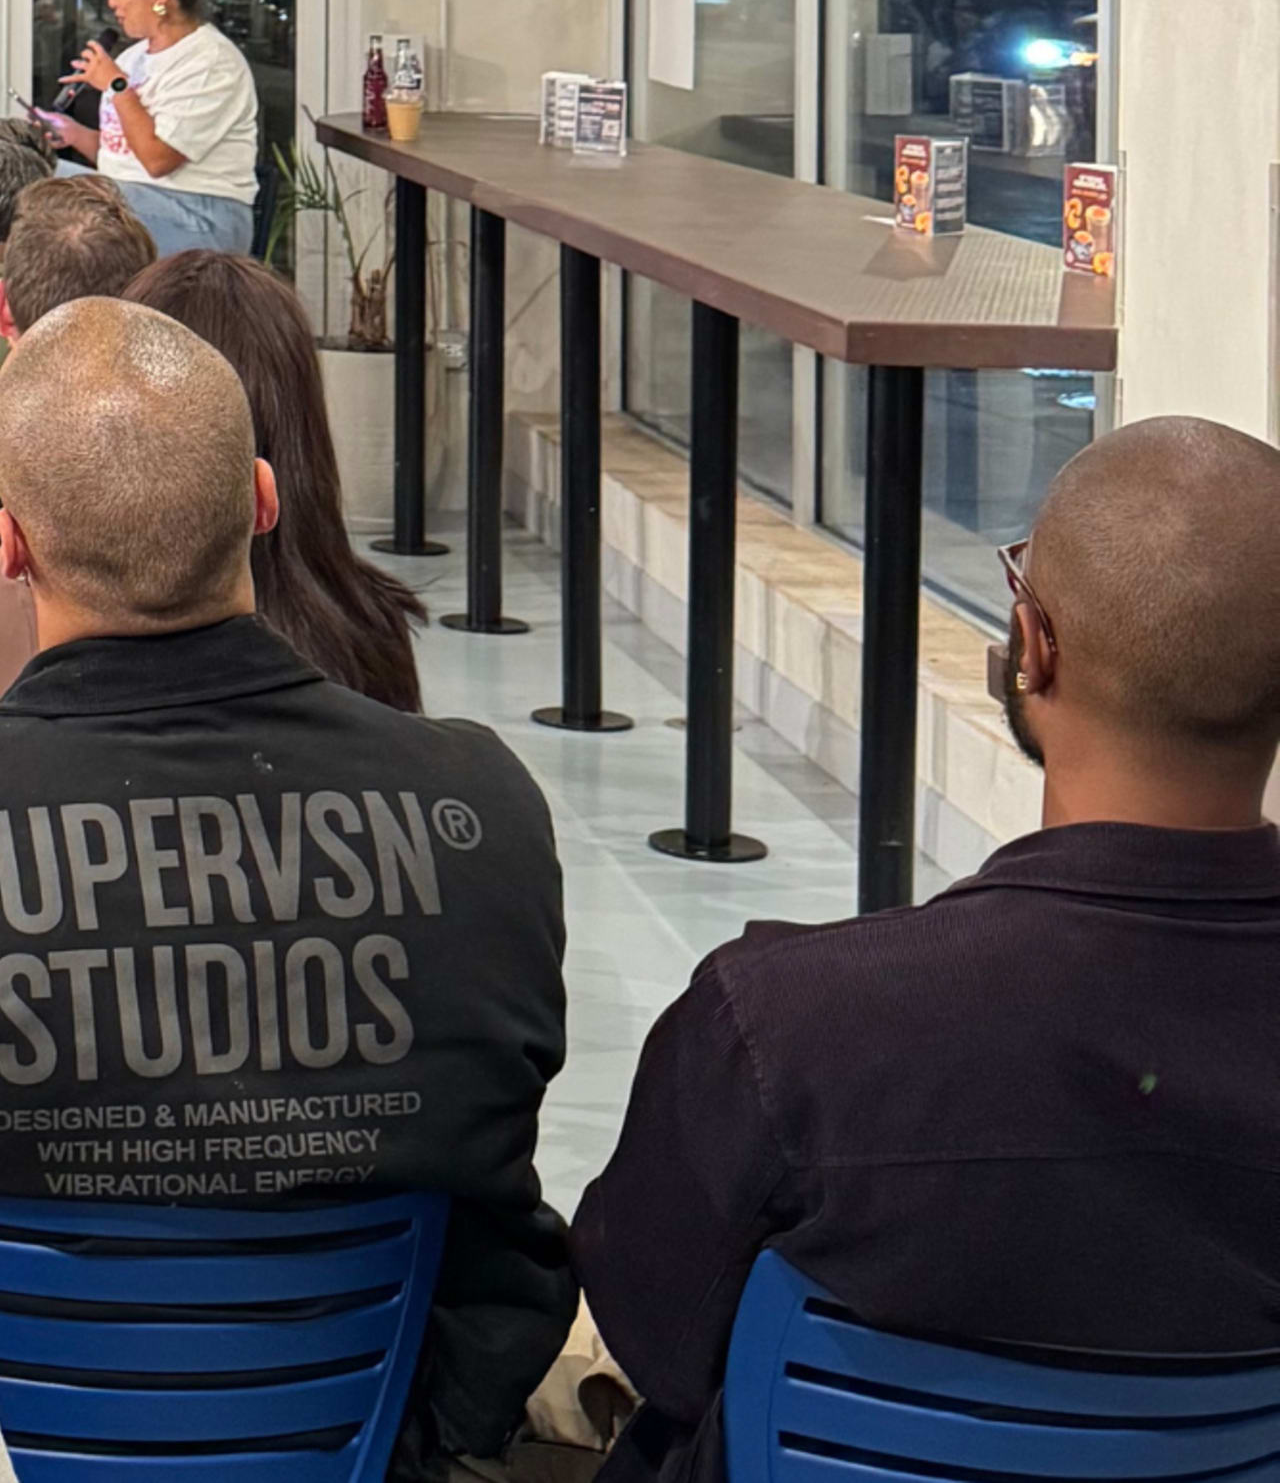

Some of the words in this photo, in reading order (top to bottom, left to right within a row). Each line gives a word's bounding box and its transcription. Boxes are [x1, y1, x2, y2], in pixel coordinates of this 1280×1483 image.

[154, 1104, 177, 1128] &
[184, 1091, 422, 1128] MANUFACTURED
[38, 1139, 114, 1163] WITH
[122, 1137, 196, 1163] HIGH
[204, 1128, 382, 1161] FREQUENCY
[43, 1172, 248, 1197] VIBRATIONAL
